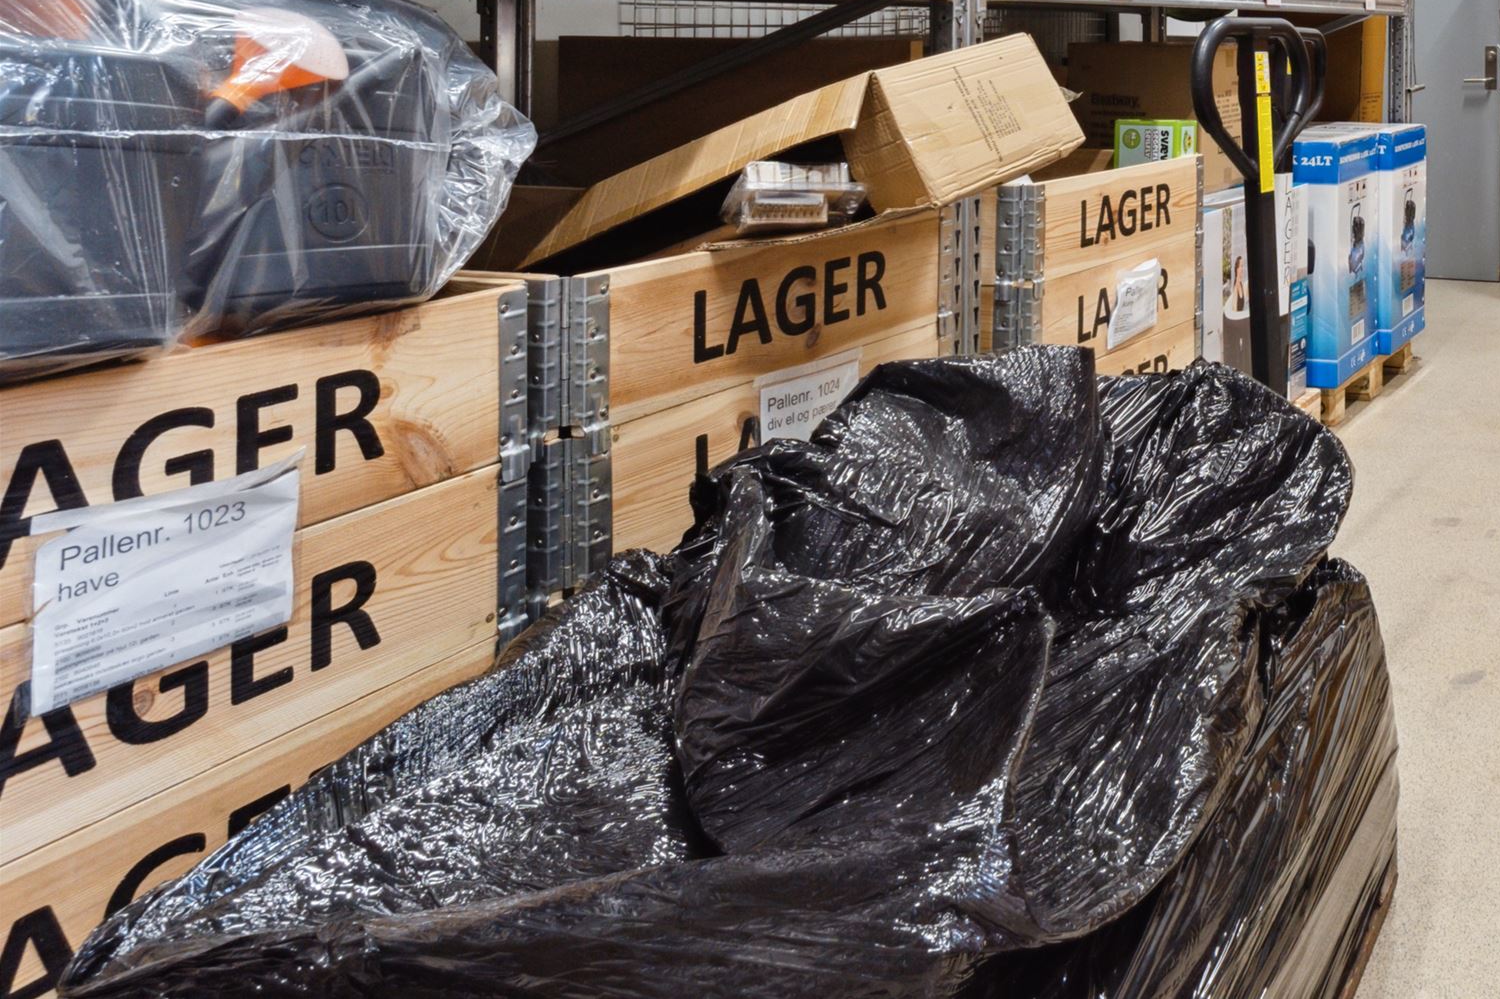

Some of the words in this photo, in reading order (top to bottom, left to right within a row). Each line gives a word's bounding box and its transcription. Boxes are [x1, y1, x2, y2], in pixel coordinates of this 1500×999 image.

[1300, 155, 1333, 167] 24LT
[1080, 183, 1171, 249] LAGER
[693, 250, 887, 364] LAGER
[1077, 268, 1169, 344] LAR
[767, 389, 813, 412] Pallenr.
[817, 377, 841, 399] 1024
[767, 417, 783, 431] div
[785, 412, 795, 425] el
[796, 409, 810, 423] og
[0, 369, 385, 569] AGER
[60, 525, 171, 571] Pallenr.
[183, 501, 247, 535] 1023
[57, 571, 120, 602] have
[0, 560, 381, 797] AGER
